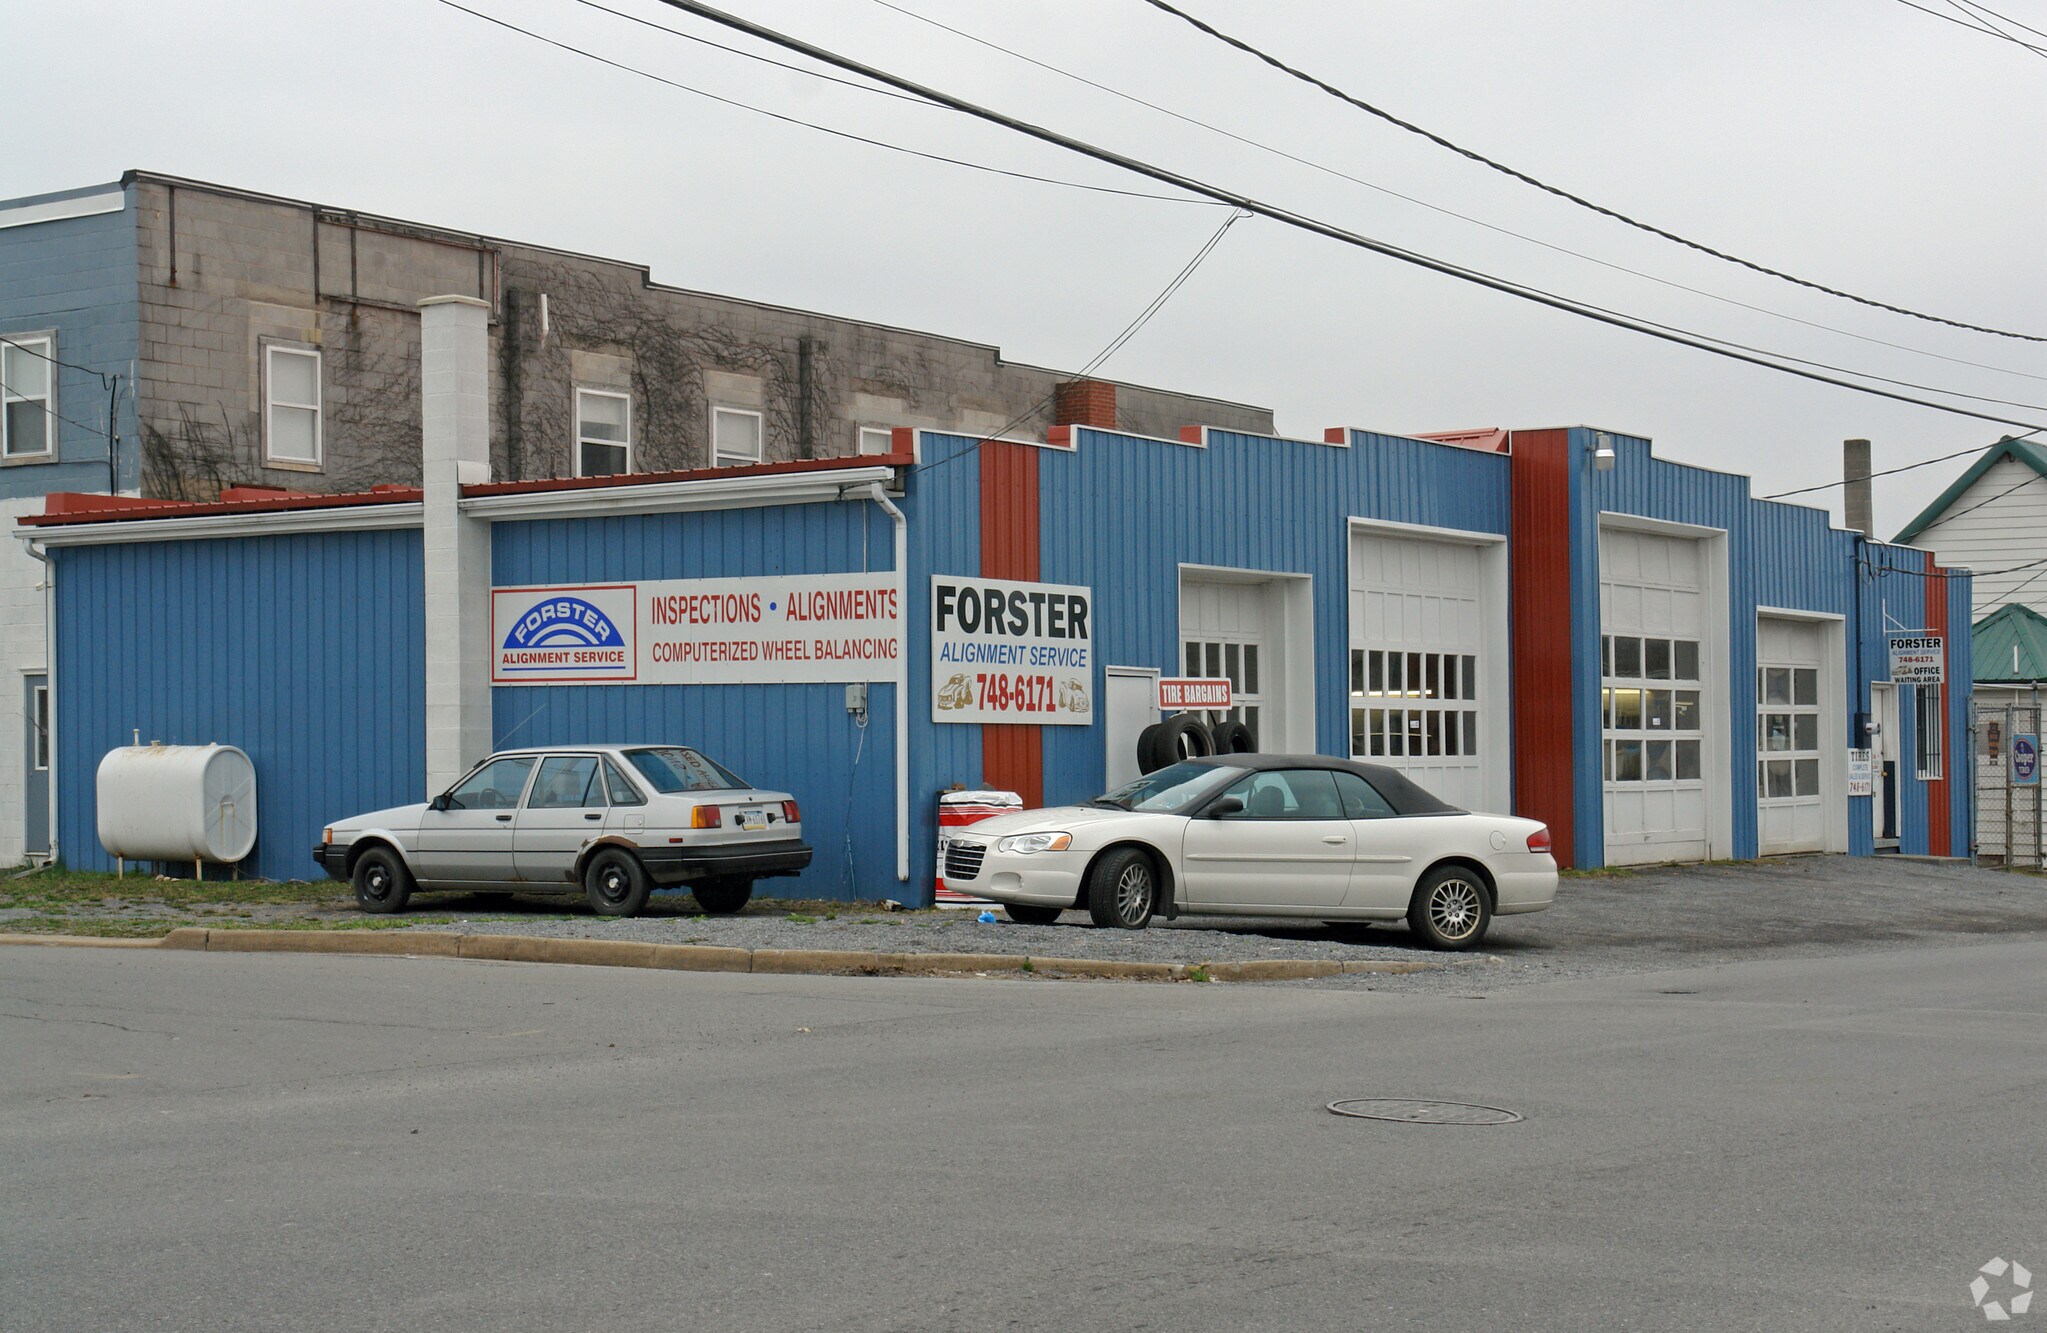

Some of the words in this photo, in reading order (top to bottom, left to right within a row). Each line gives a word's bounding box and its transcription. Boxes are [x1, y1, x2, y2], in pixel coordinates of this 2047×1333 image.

[652, 593, 761, 624] INSPECTIONS
[786, 588, 897, 622] ALIGNMENTS
[937, 585, 1088, 639] FORSTER
[514, 602, 611, 642] FORSTER
[653, 641, 758, 662] COMPUTERIZED
[762, 640, 811, 661] WHEEL
[815, 638, 898, 660] BALANCING
[940, 642, 1027, 665] ALIGNMENT
[1029, 646, 1087, 667] SERVICE
[1890, 638, 1941, 649] FORSTER
[502, 652, 570, 664] ALIGNMENT
[573, 651, 624, 663] SERVICE
[1914, 666, 1941, 675] OFFICE
[977, 673, 1056, 712] 748-6171
[1162, 685, 1181, 703] TIRE
[1184, 684, 1228, 703] BARGAINS
